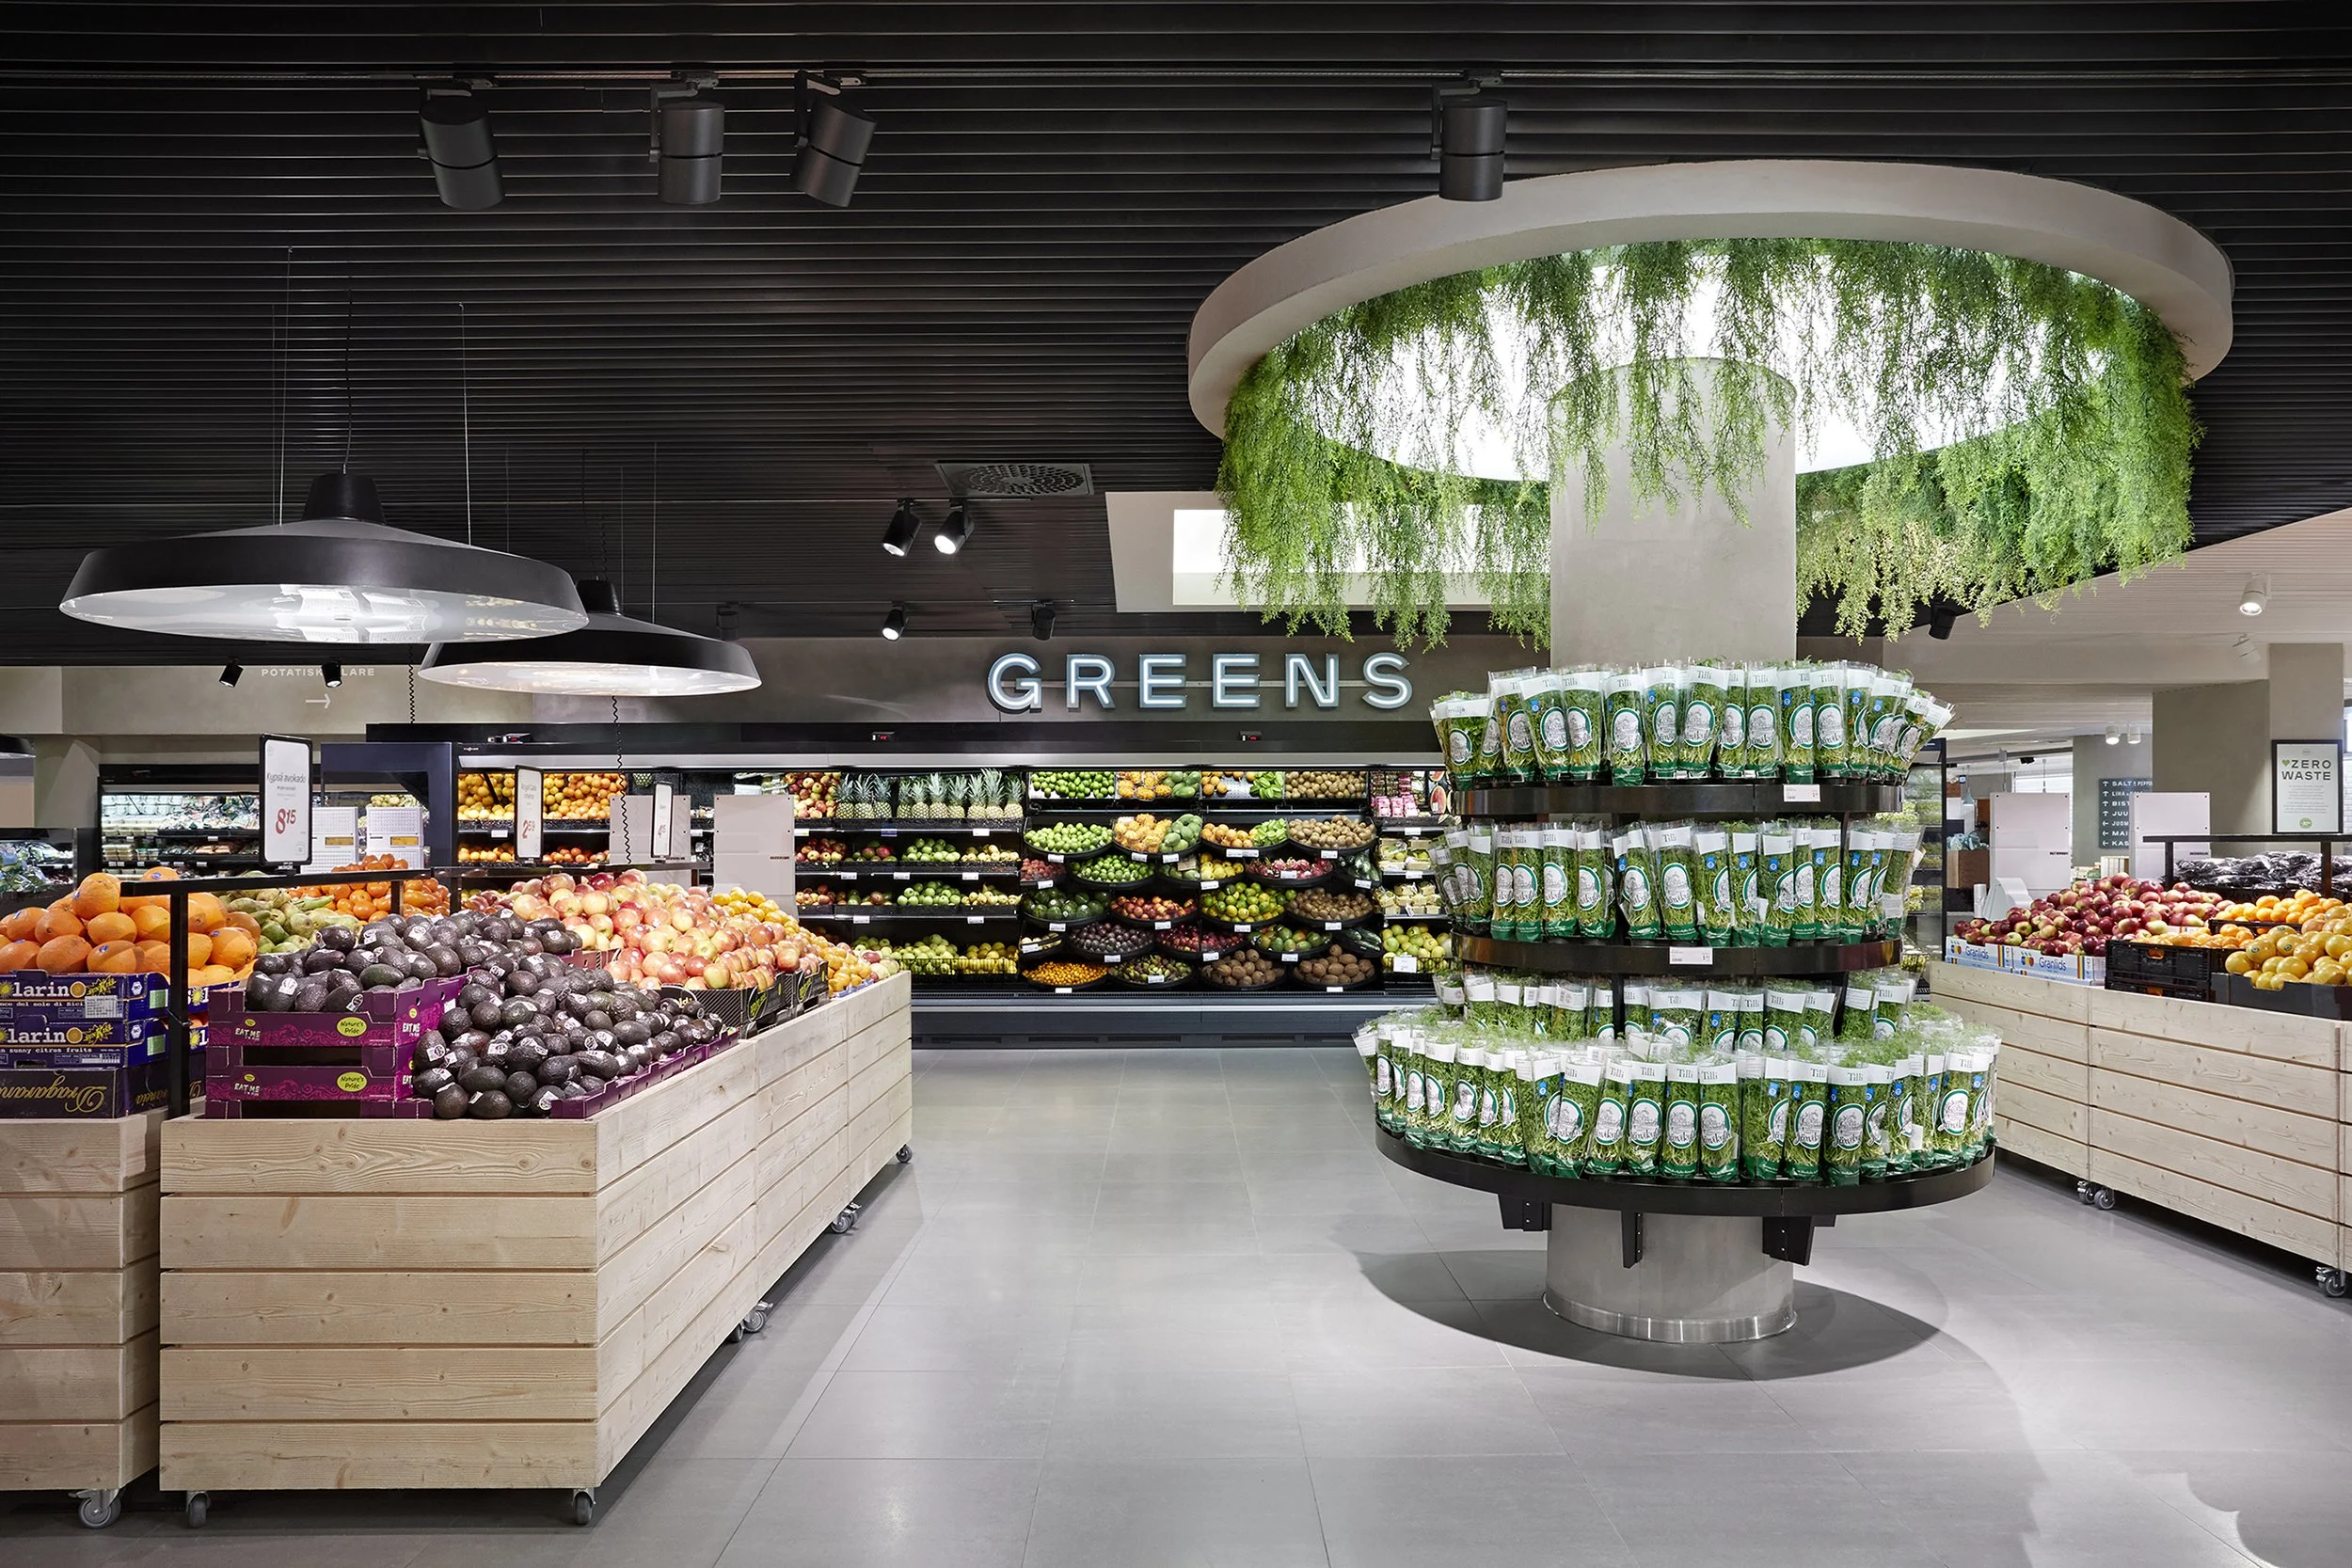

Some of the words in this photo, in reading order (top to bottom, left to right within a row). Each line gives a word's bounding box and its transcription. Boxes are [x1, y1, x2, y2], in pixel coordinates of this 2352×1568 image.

[261, 668, 374, 676] POTATISKLARE
[986, 652, 1412, 710] GREENS
[2291, 759, 2331, 768] ZERO
[284, 773, 306, 784] avokado
[2281, 771, 2331, 781] WASTE
[235, 1027, 249, 1037] EAT
[234, 1083, 248, 1093] EAT
[0, 1075, 107, 1113] Dragaran
